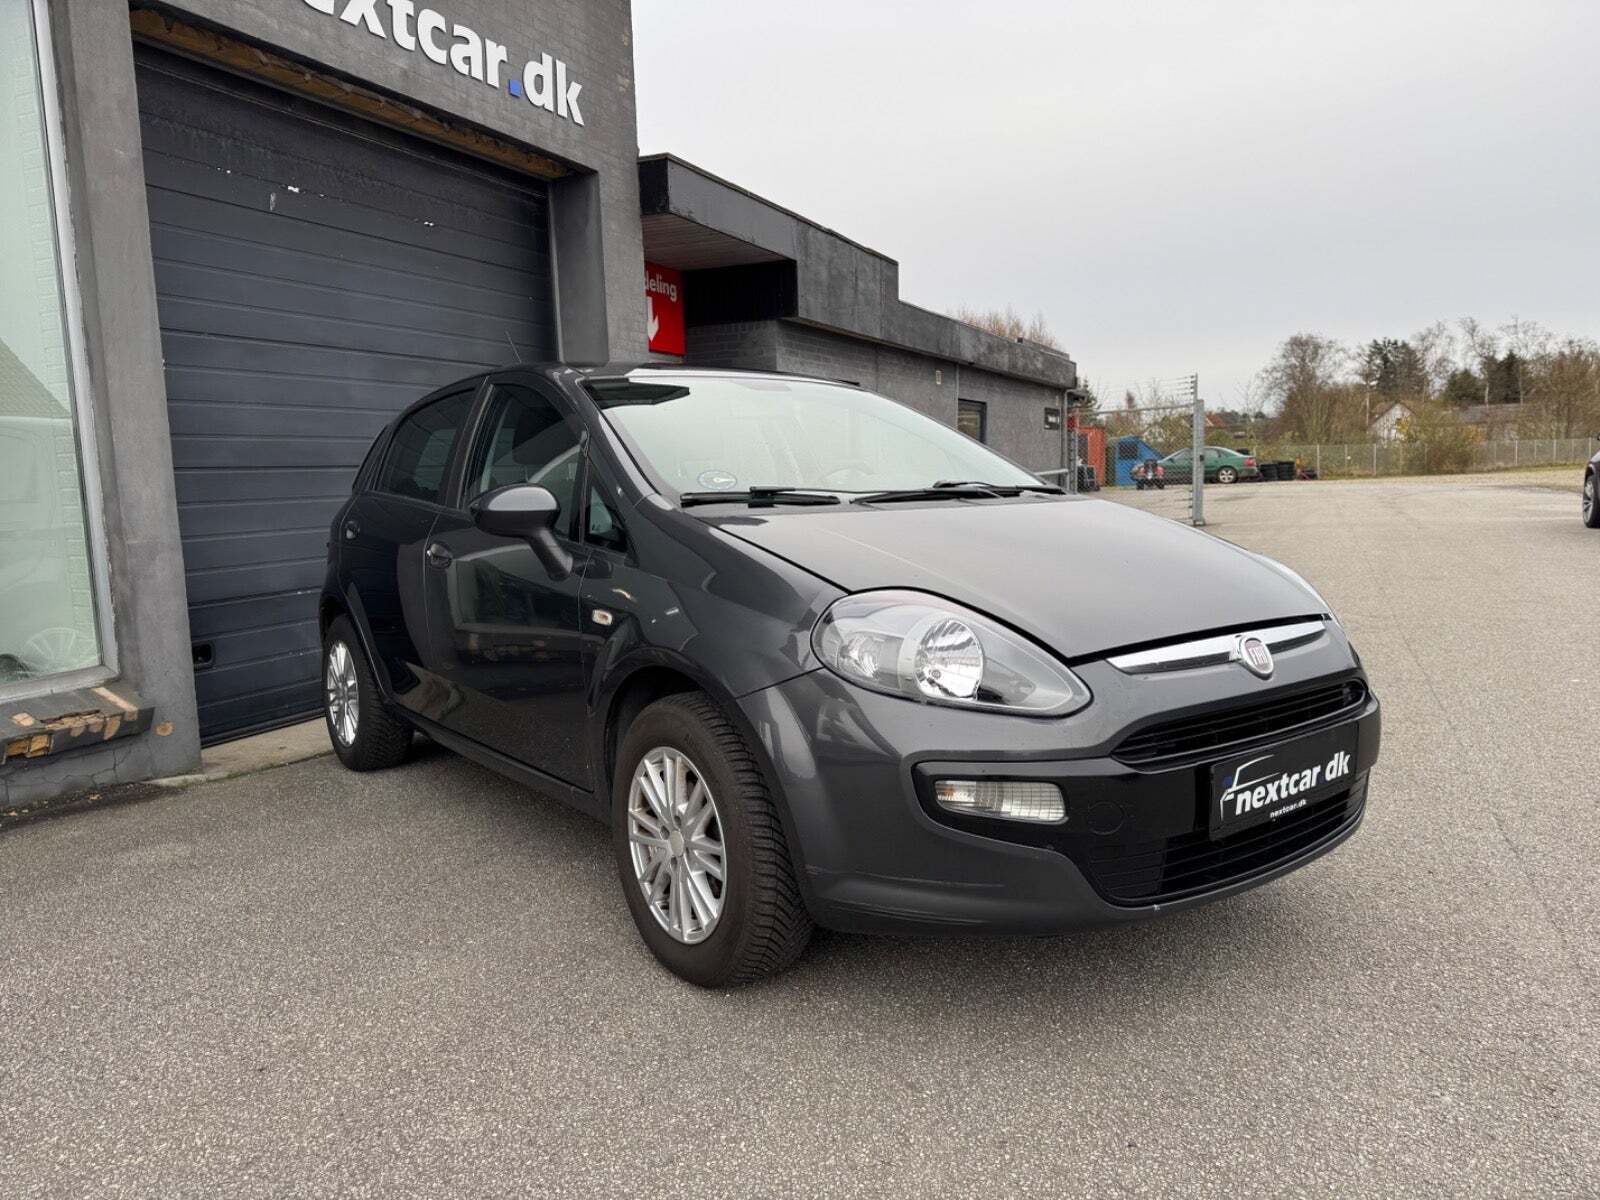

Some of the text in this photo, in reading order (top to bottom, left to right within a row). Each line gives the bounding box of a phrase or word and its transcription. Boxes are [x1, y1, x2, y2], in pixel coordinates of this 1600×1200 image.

[303, 0, 584, 126] xtcar.dk
[1235, 751, 1350, 816] nextcar.dk
[1269, 799, 1306, 819] nextcar.dk
